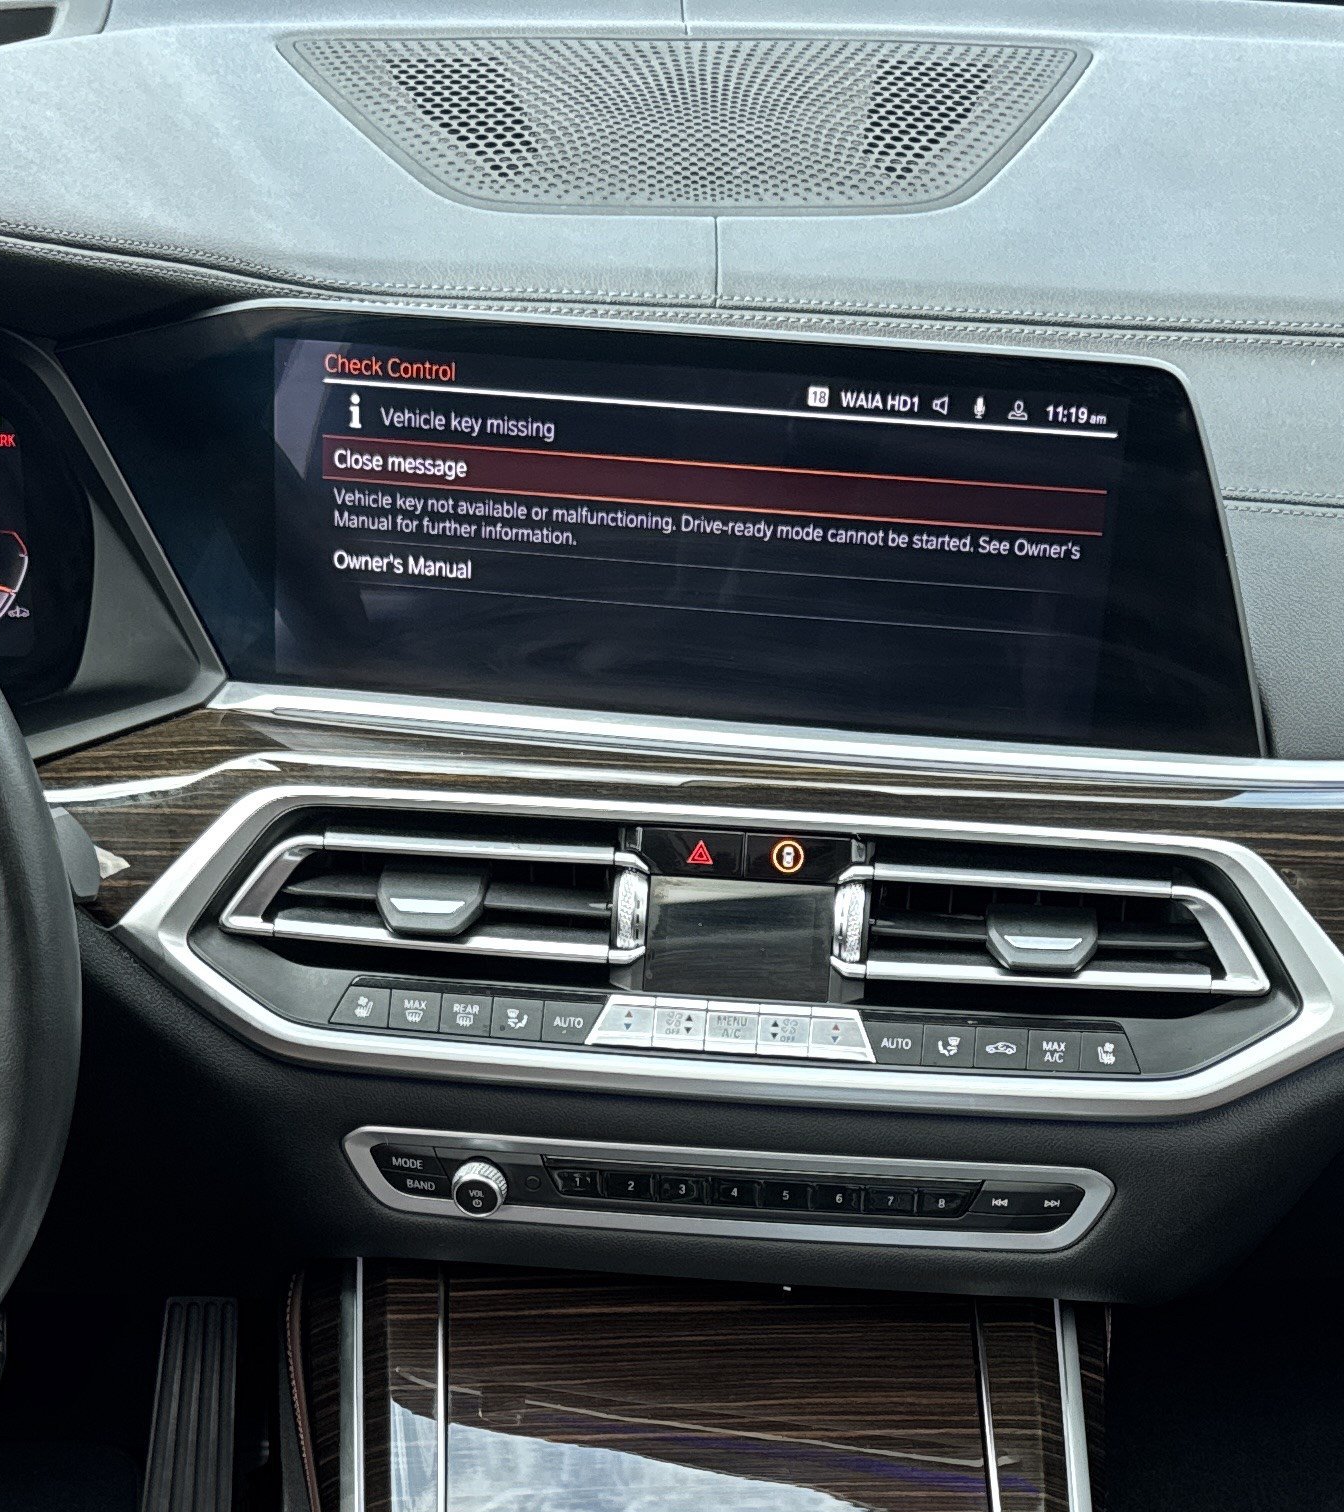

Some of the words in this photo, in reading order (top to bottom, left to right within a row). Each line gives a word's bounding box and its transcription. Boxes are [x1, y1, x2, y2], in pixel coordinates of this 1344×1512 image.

[325, 354, 382, 376] Check
[388, 358, 456, 381] Control
[811, 390, 828, 404] 18
[841, 390, 883, 410] WAIA
[887, 394, 920, 413] HD1
[1045, 405, 1088, 425] 11:19
[1089, 414, 1107, 425] am
[380, 407, 445, 430] Vehicle
[451, 410, 482, 437] key
[488, 414, 555, 442] missing
[334, 448, 383, 472] Close
[387, 454, 468, 480] message
[334, 487, 392, 510] Vehicle
[396, 492, 424, 516] key
[427, 497, 454, 514] not
[458, 498, 527, 520] available
[531, 508, 549, 521] or
[553, 505, 677, 534] malfunctioning.
[681, 514, 773, 541] Drive-ready
[777, 524, 823, 542] mode
[827, 529, 884, 548] cannot
[888, 529, 909, 548] be
[912, 533, 974, 553] started.
[978, 536, 1010, 556] See
[1014, 540, 1081, 560] Owner's
[334, 510, 393, 531] Manual
[397, 514, 419, 532] for
[423, 517, 477, 538] further
[481, 522, 577, 546] information.
[334, 550, 404, 574] Owner's
[408, 555, 472, 579] Manual
[404, 998, 427, 1011] MAX
[453, 1003, 479, 1015] REAR
[553, 1016, 584, 1029] AUTO
[716, 1015, 748, 1027] MENU
[665, 1027, 681, 1035] OFF
[721, 1028, 741, 1039] A/C
[880, 1038, 912, 1050] AUTO
[1042, 1041, 1066, 1052] MAX
[1044, 1052, 1064, 1063] A/C
[392, 1156, 424, 1170] MODE
[406, 1178, 436, 1191] BAND
[574, 1176, 580, 1188] 1
[627, 1180, 635, 1191] 2
[469, 1188, 485, 1198] VOL
[678, 1184, 686, 1194] 3
[731, 1187, 738, 1198] 4
[782, 1190, 790, 1201] 5
[836, 1194, 843, 1204] 6
[887, 1196, 894, 1207] 7
[938, 1198, 946, 1209] 8
